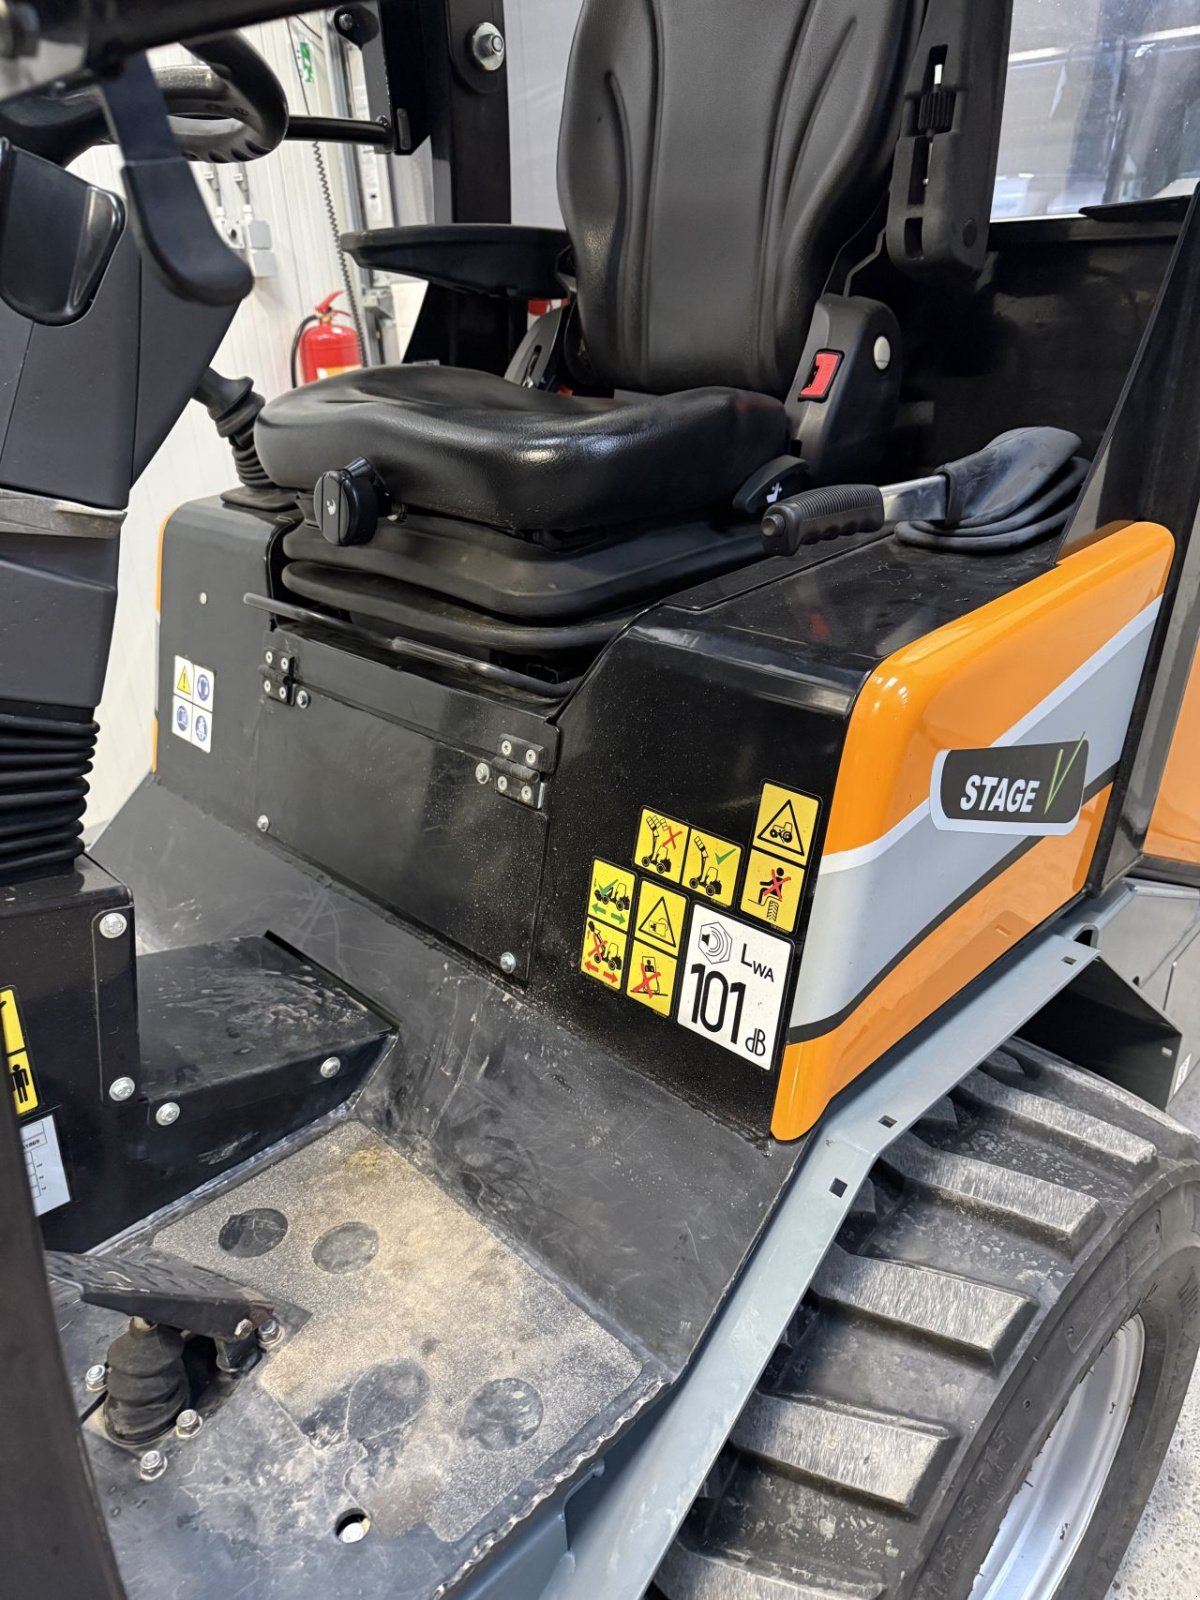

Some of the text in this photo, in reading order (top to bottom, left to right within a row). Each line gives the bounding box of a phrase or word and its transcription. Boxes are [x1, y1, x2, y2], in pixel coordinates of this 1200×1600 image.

[960, 774, 1040, 813] STAGE
[690, 963, 766, 1057] 101 dB
